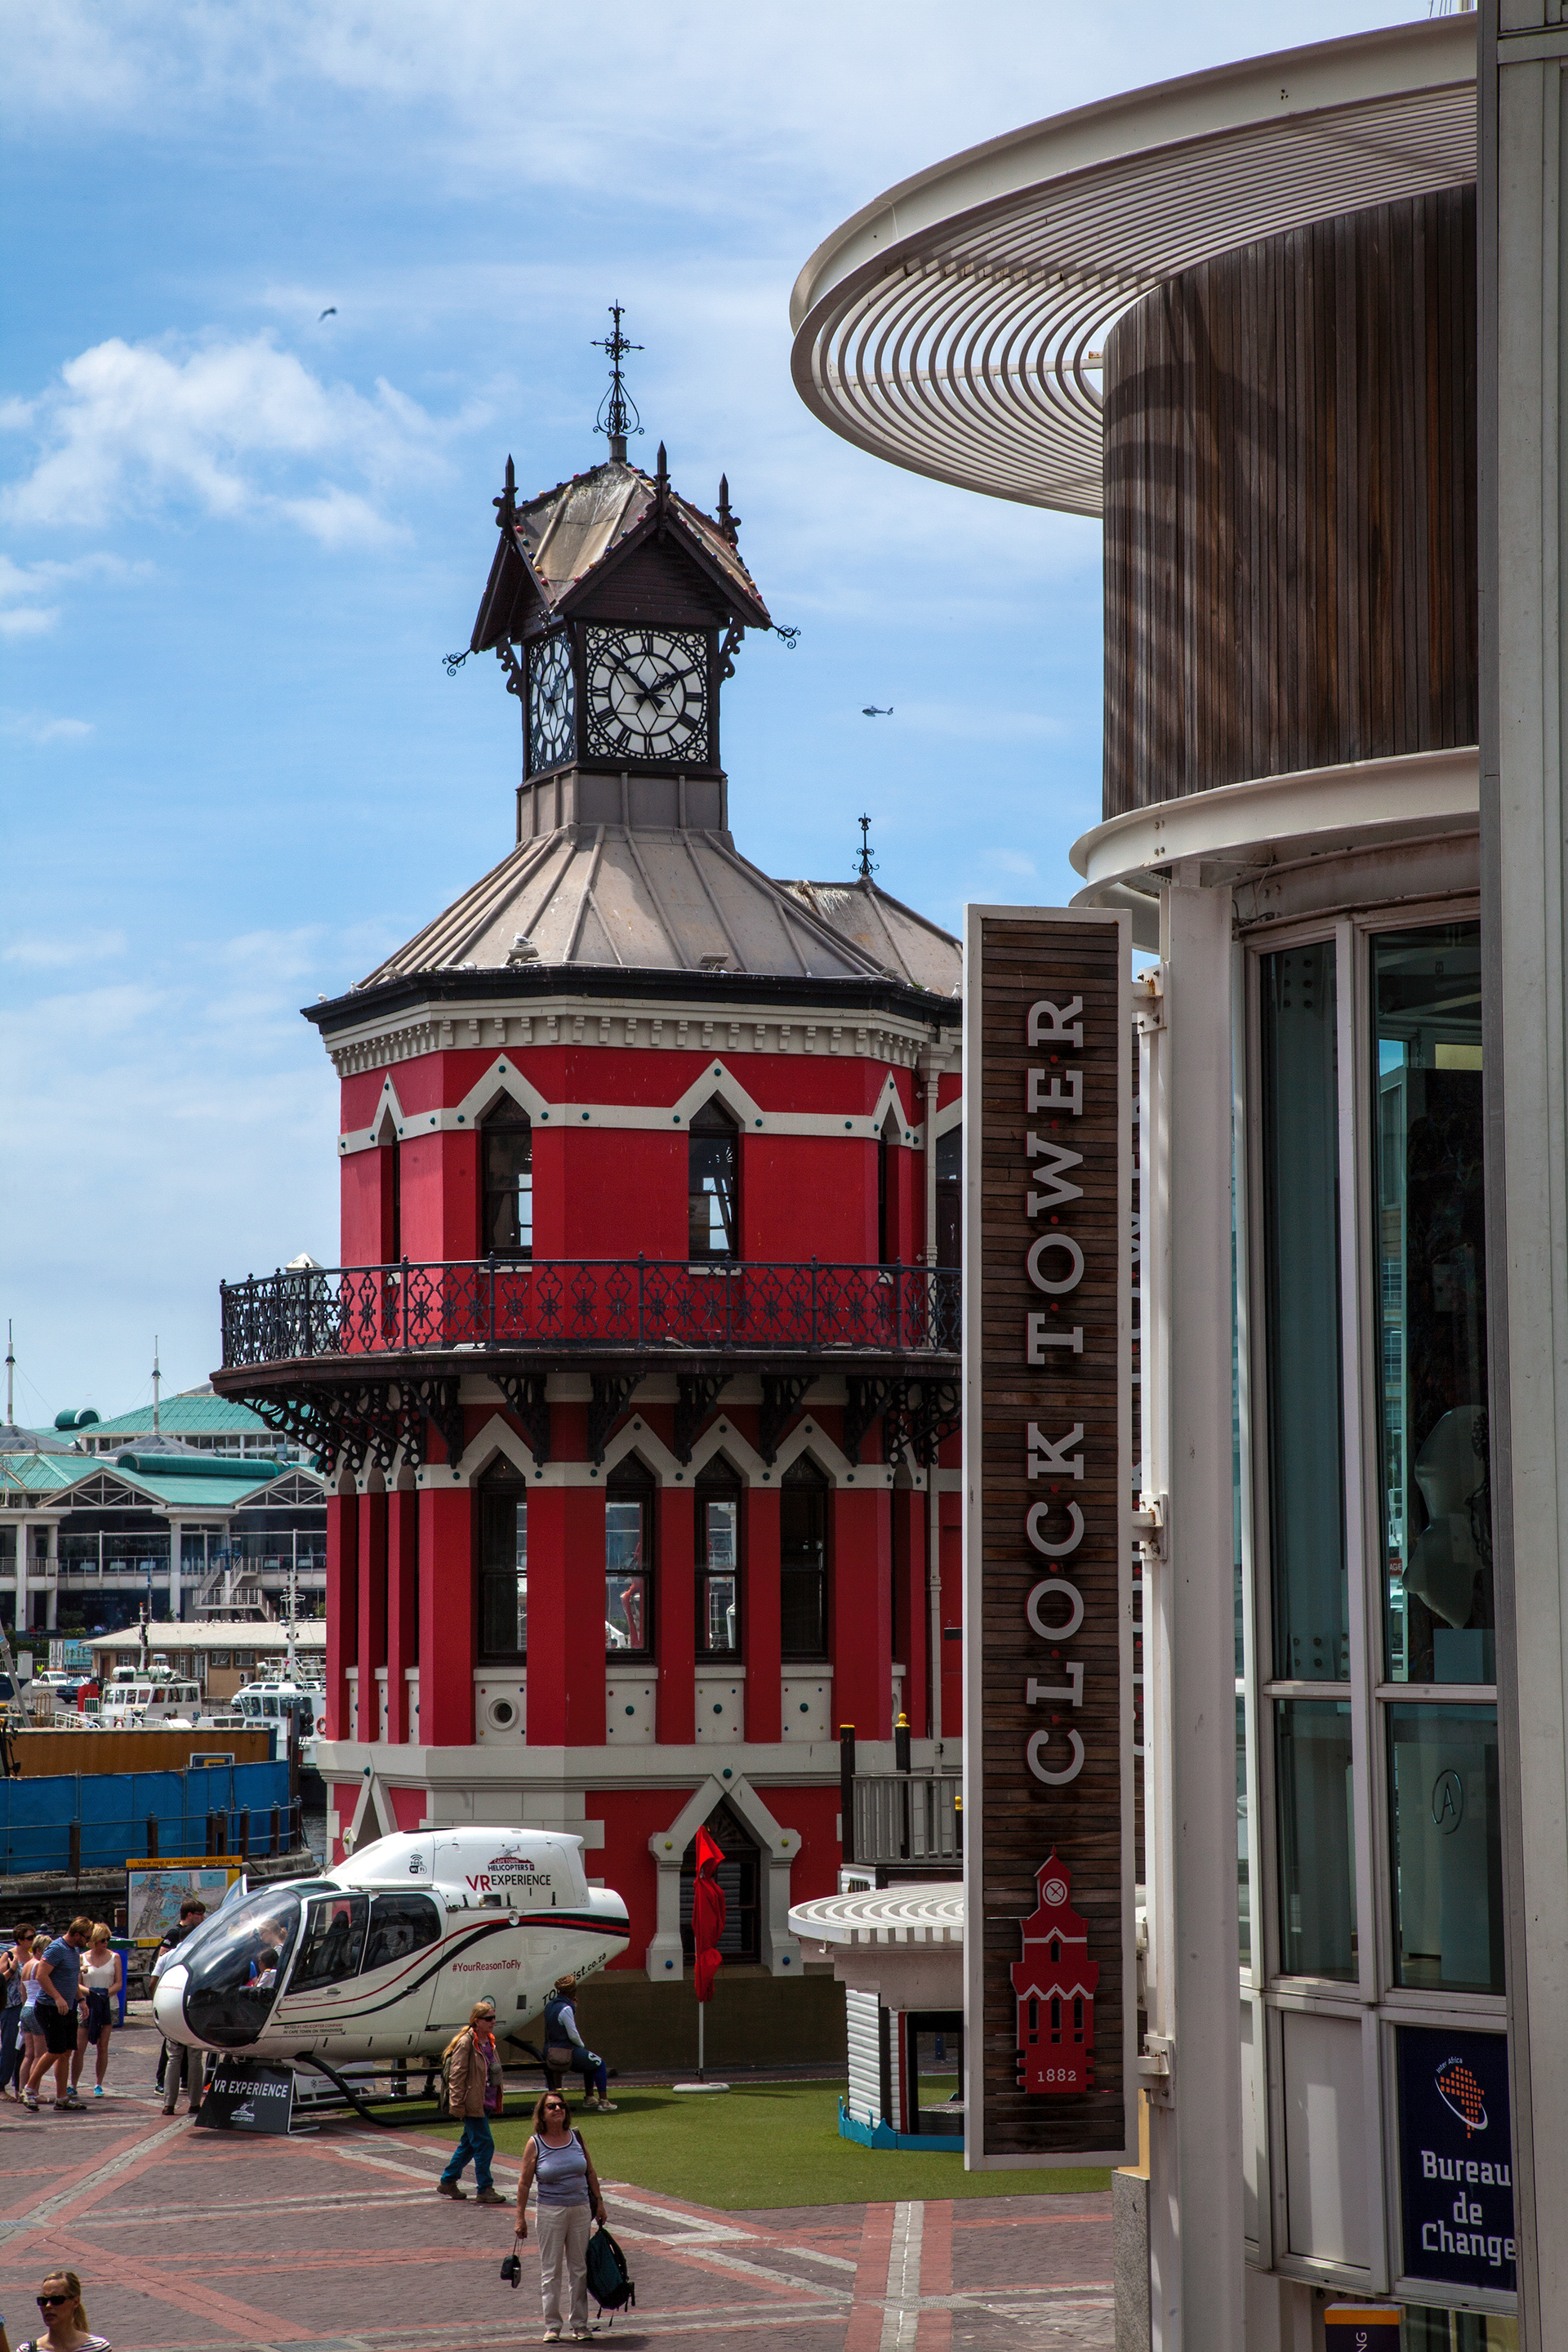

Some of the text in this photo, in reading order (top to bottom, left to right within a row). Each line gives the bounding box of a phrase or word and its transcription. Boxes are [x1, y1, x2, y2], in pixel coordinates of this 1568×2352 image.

[172, 1857, 232, 1865] www.waterfront.co.za
[488, 1864, 529, 1872] HELICOPTERS
[466, 1874, 551, 1891] VR EXPERIENCE
[452, 1959, 522, 1973] #YourReasonToFly
[1448, 2056, 1463, 2065] Africa
[1037, 2068, 1076, 2082] 1882
[214, 2079, 288, 2098] VR EXPERIENCE
[1421, 2149, 1511, 2187] Bureau
[1453, 2191, 1483, 2225] de
[1421, 2220, 1517, 2267] Change
